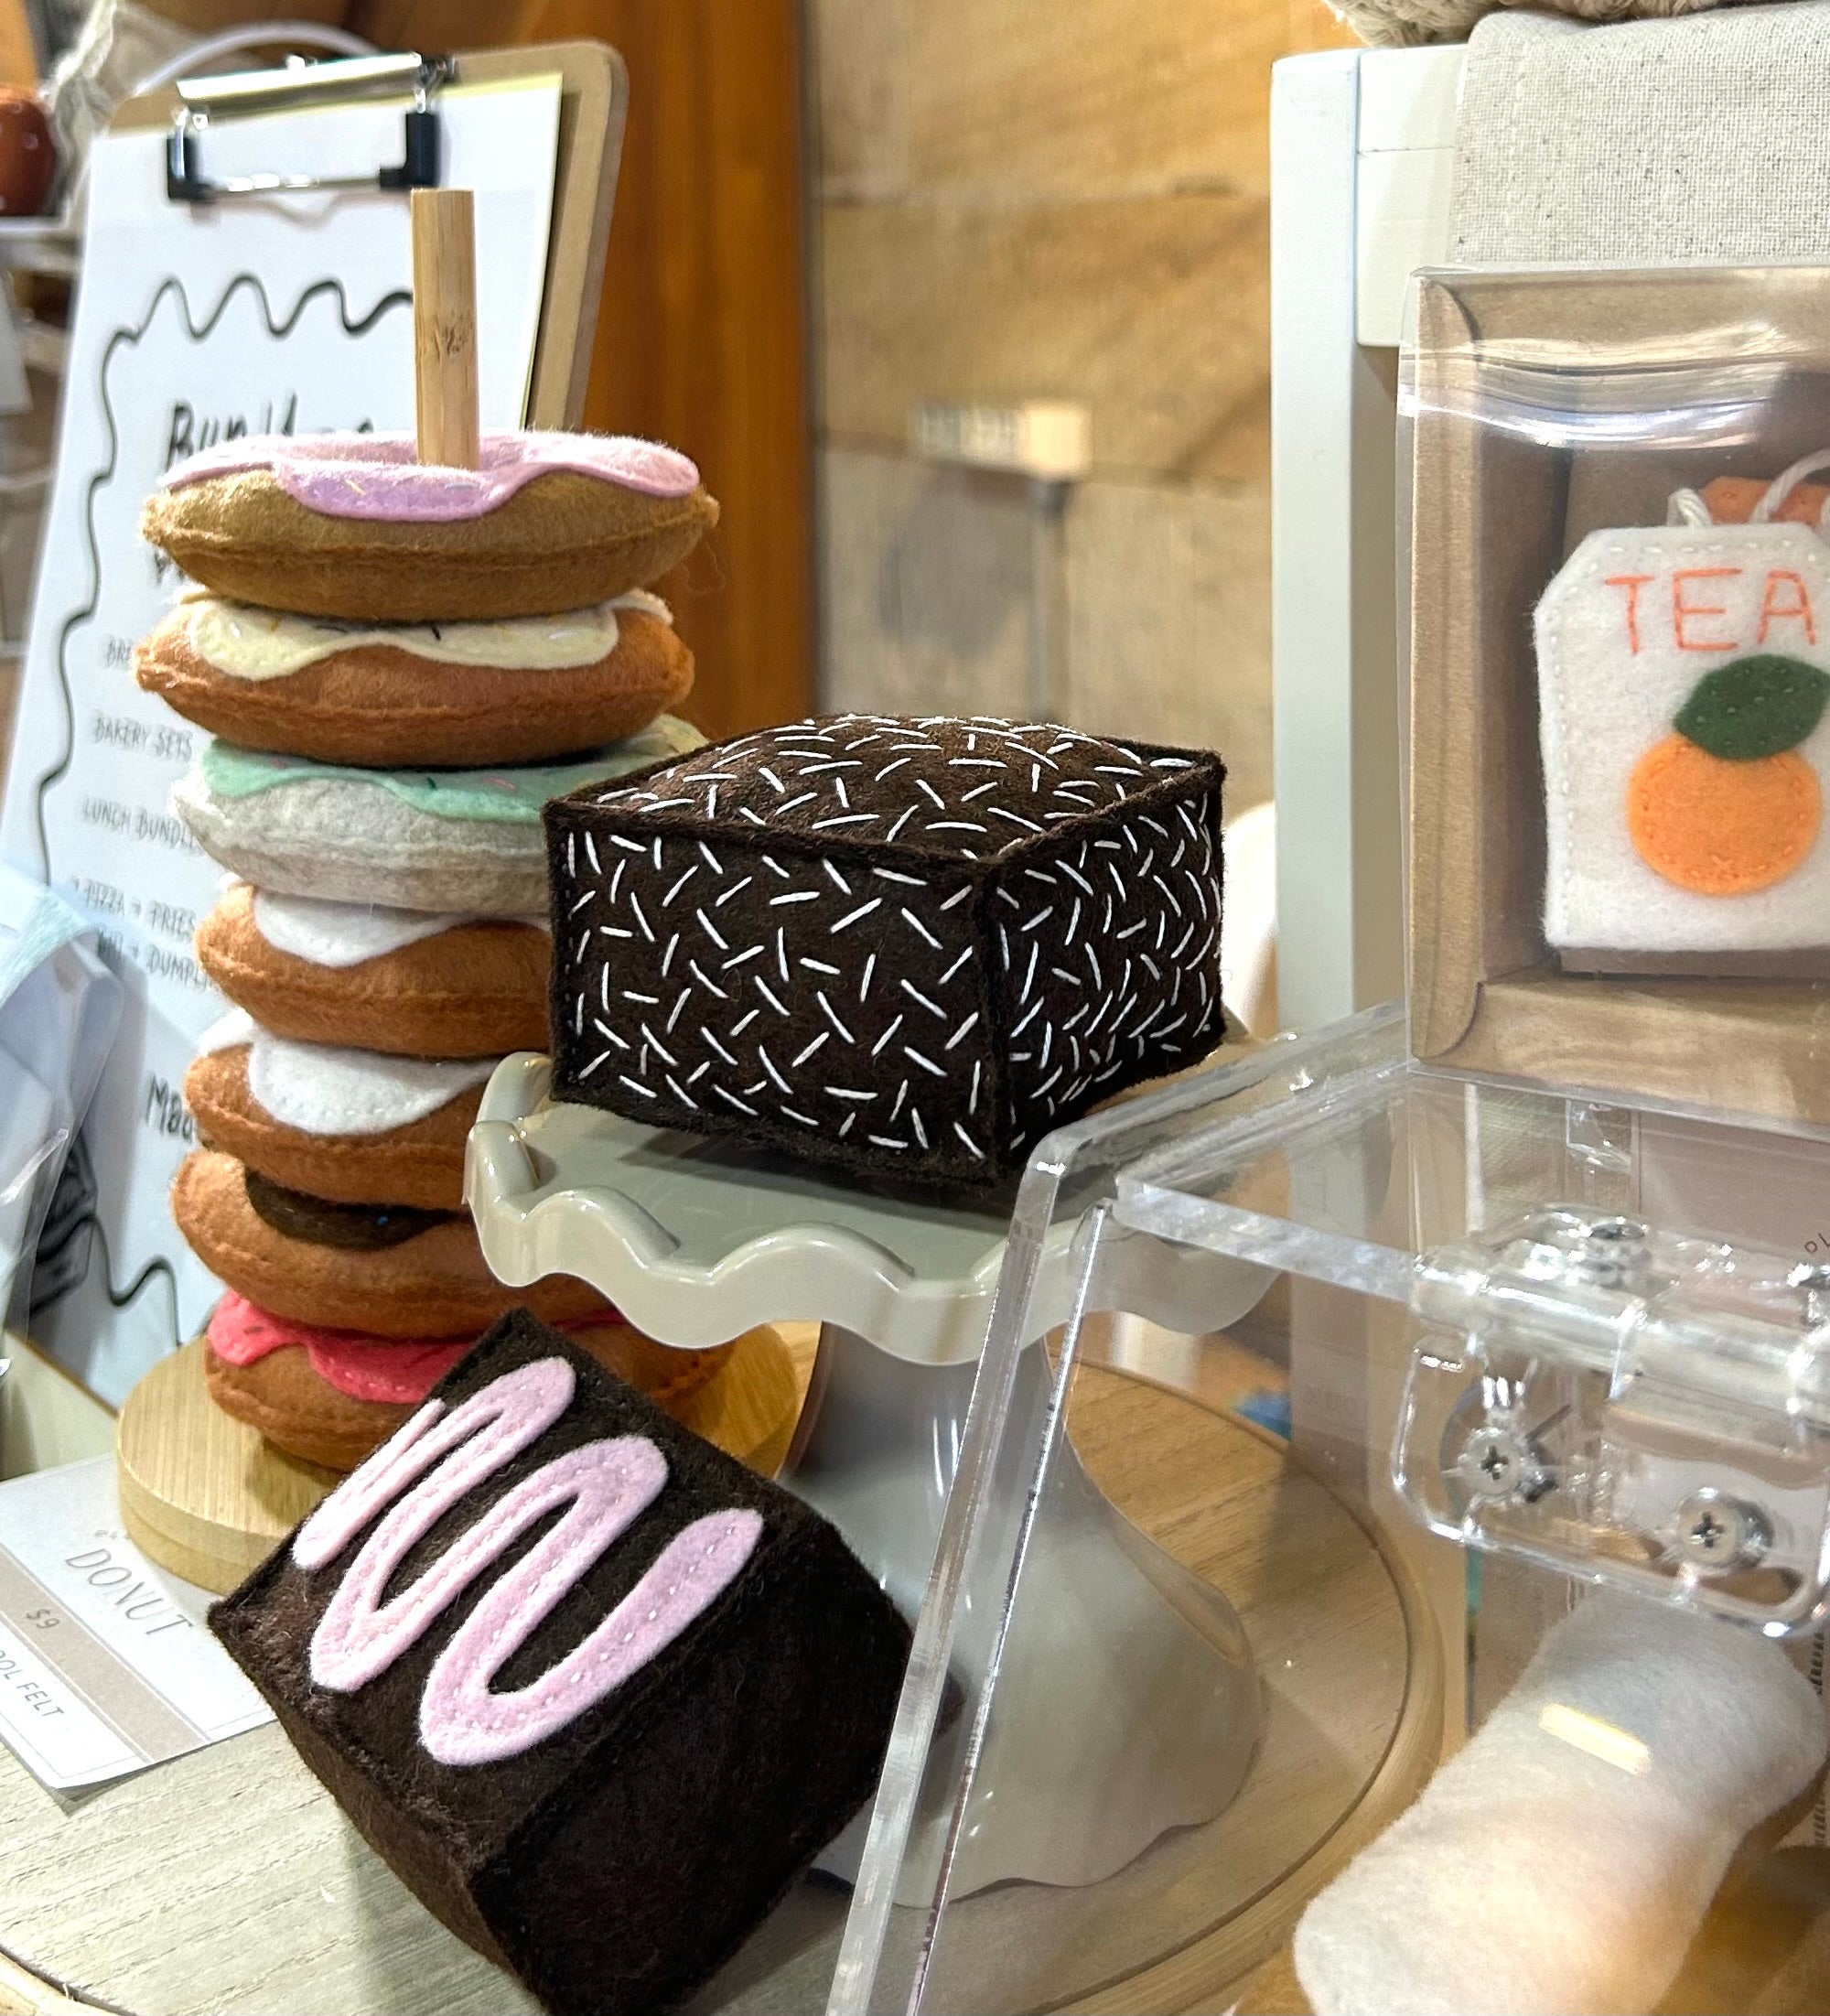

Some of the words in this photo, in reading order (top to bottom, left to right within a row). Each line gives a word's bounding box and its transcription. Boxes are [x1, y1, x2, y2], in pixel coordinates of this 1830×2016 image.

[1603, 566, 1816, 655] TEA
[93, 711, 149, 750] BAKERY
[82, 792, 132, 835] LUNCH
[84, 878, 125, 916] PIZZA
[147, 900, 197, 942] FRIES
[65, 1547, 193, 1635] DONUT
[25, 1608, 60, 1629] $9
[16, 1682, 65, 1717] FELT
